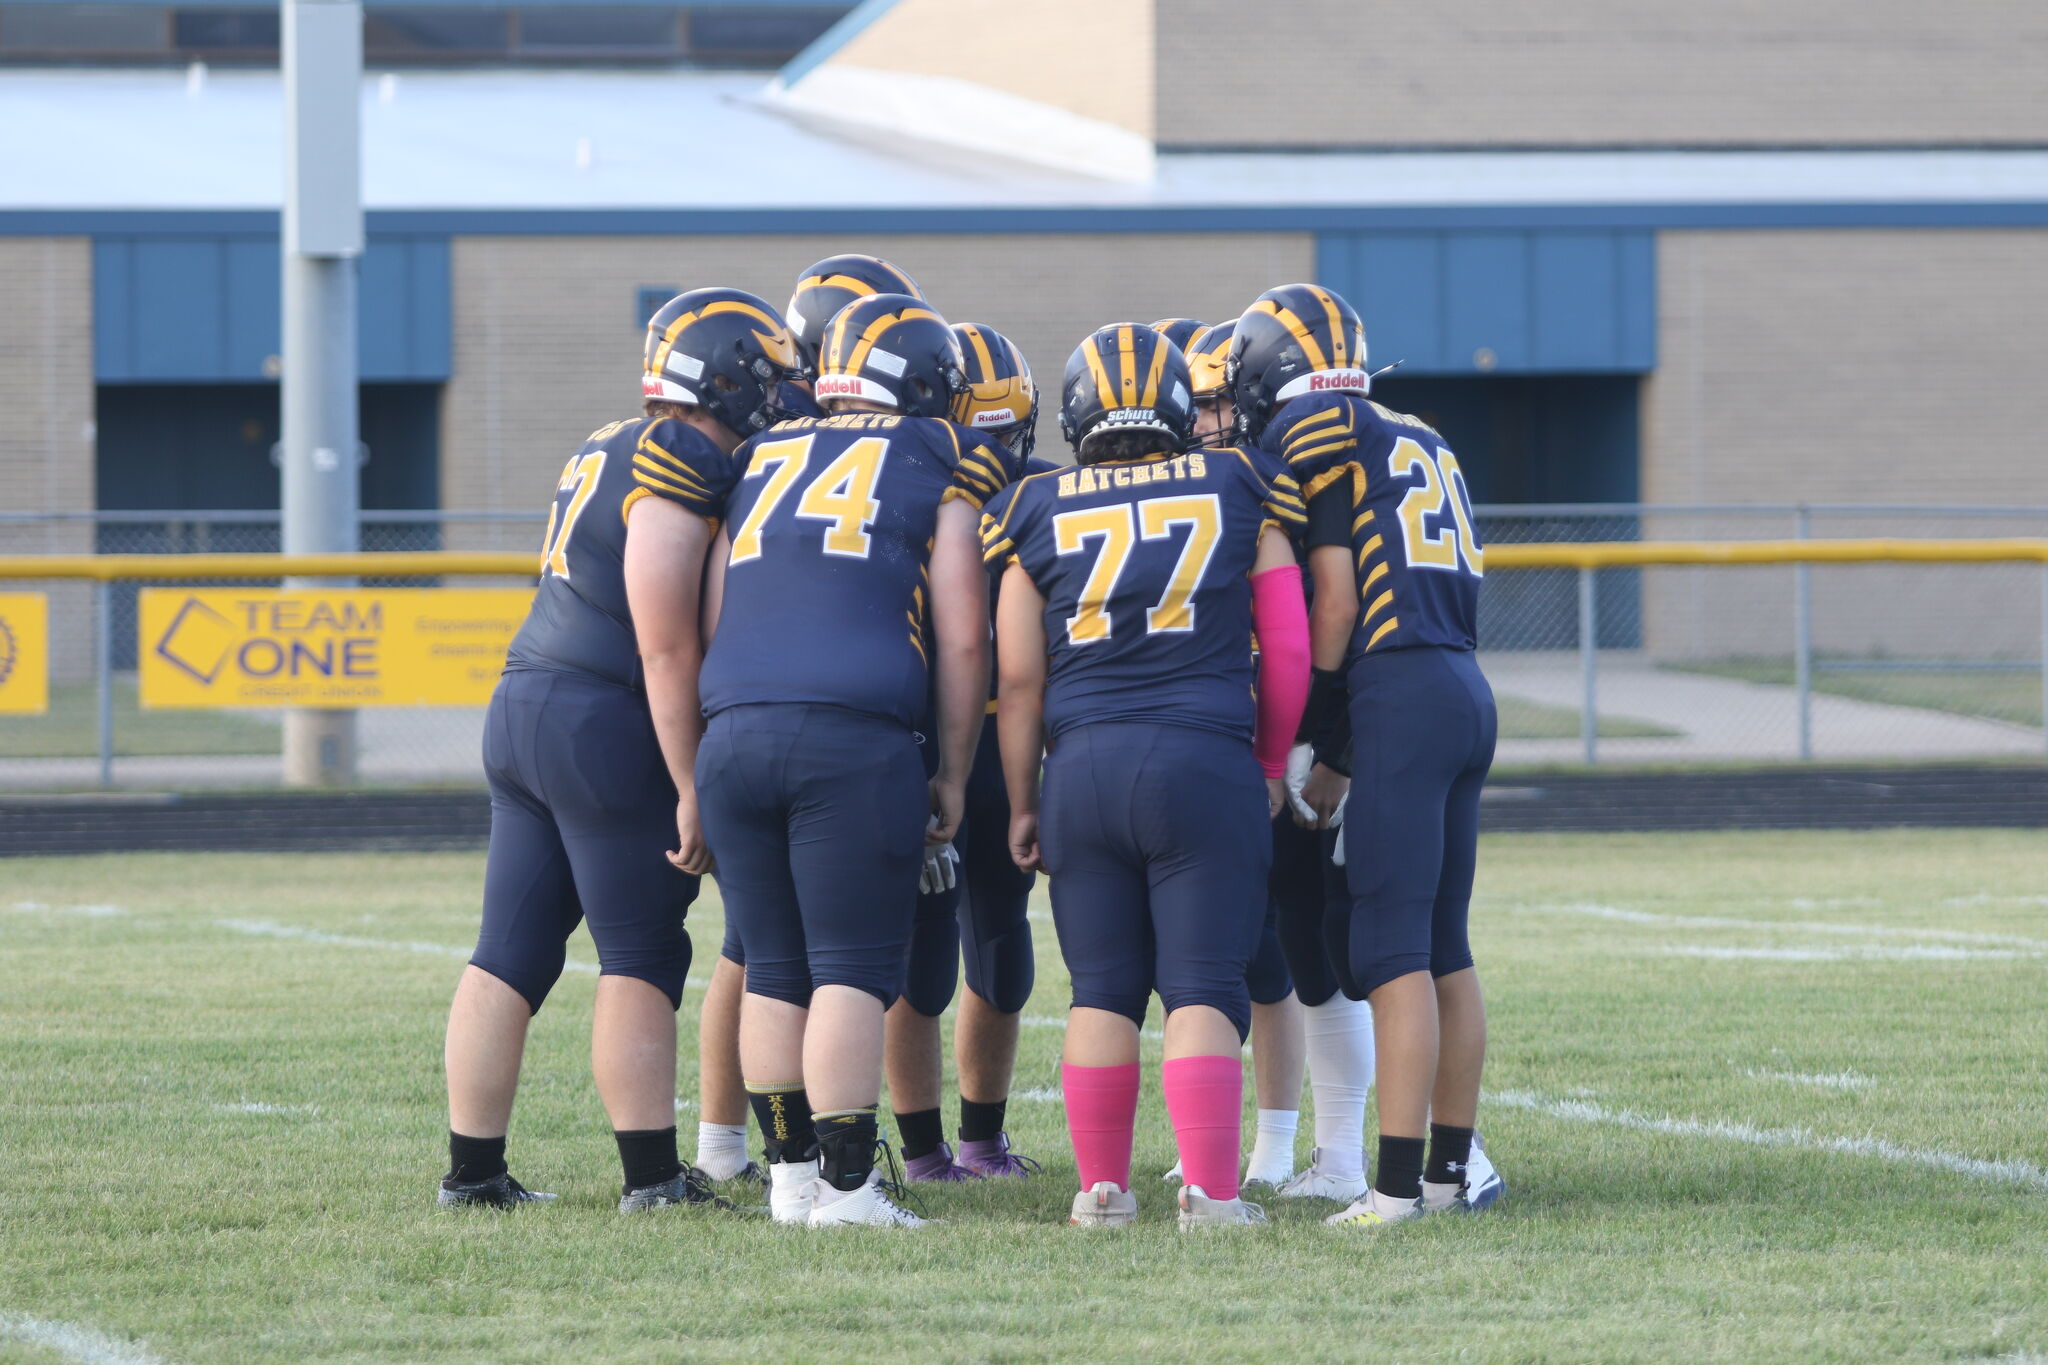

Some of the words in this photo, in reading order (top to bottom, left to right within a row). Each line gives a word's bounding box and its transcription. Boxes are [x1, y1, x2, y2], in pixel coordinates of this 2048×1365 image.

[1310, 373, 1364, 391] Riddell
[978, 411, 1011, 423] Riddell
[1107, 407, 1155, 422] schutt
[1058, 453, 1207, 497] HATCHETS
[729, 432, 890, 567] 74
[1388, 436, 1484, 578] 20
[1052, 493, 1223, 646] 77
[236, 600, 384, 632] TEAM
[237, 637, 380, 678] ONE
